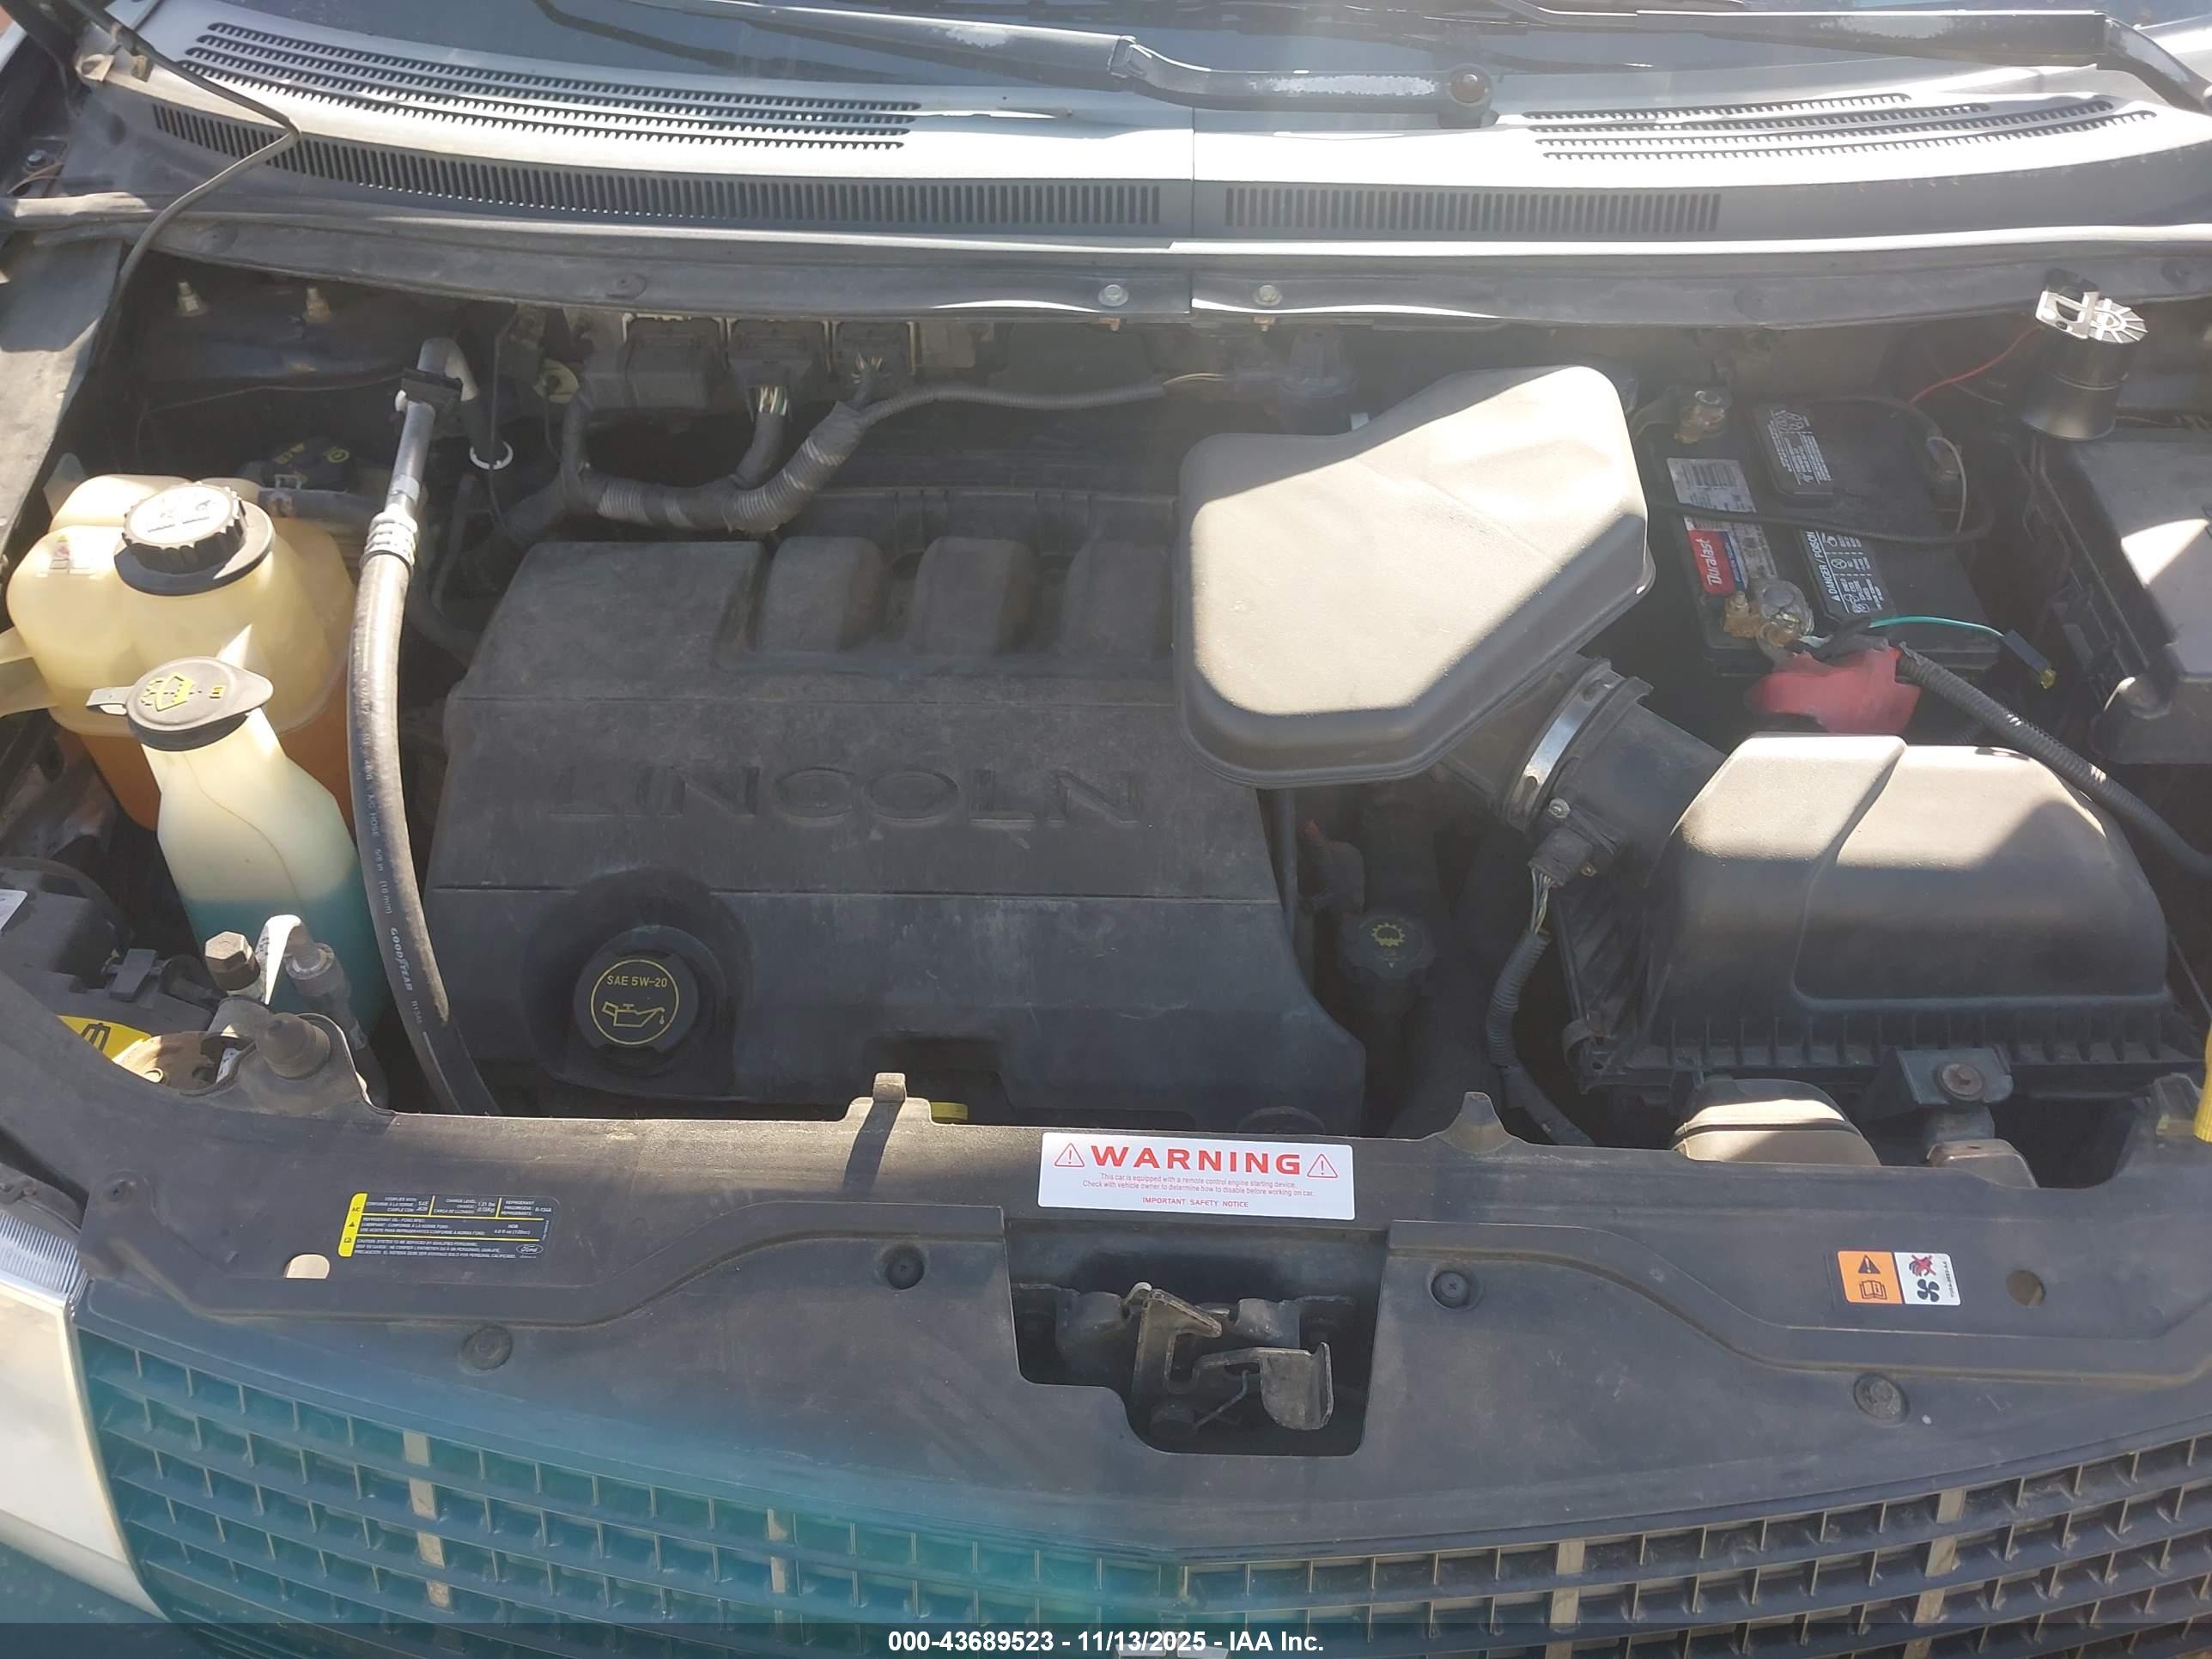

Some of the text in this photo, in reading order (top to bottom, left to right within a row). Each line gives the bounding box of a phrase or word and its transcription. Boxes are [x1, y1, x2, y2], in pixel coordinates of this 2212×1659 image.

[1696, 538, 1723, 586] Duralast
[1818, 564, 1838, 594] DANGER
[550, 764, 1139, 823] LINCOLN
[370, 812, 379, 837] HOSE
[390, 927, 414, 992] GOODYEAR
[606, 975, 667, 988] SAE 5W-20
[1091, 1145, 1300, 1175] WARNING
[1133, 1175, 1162, 1183] equipped
[1228, 1179, 1249, 1188] engine
[1250, 1180, 1273, 1189] starting
[1169, 1183, 1200, 1192] determine
[1223, 1186, 1245, 1194] disable
[1268, 1188, 1292, 1197] working
[1143, 1197, 1186, 1206] IMPORTANT
[1190, 1199, 1218, 1207] SAFETY
